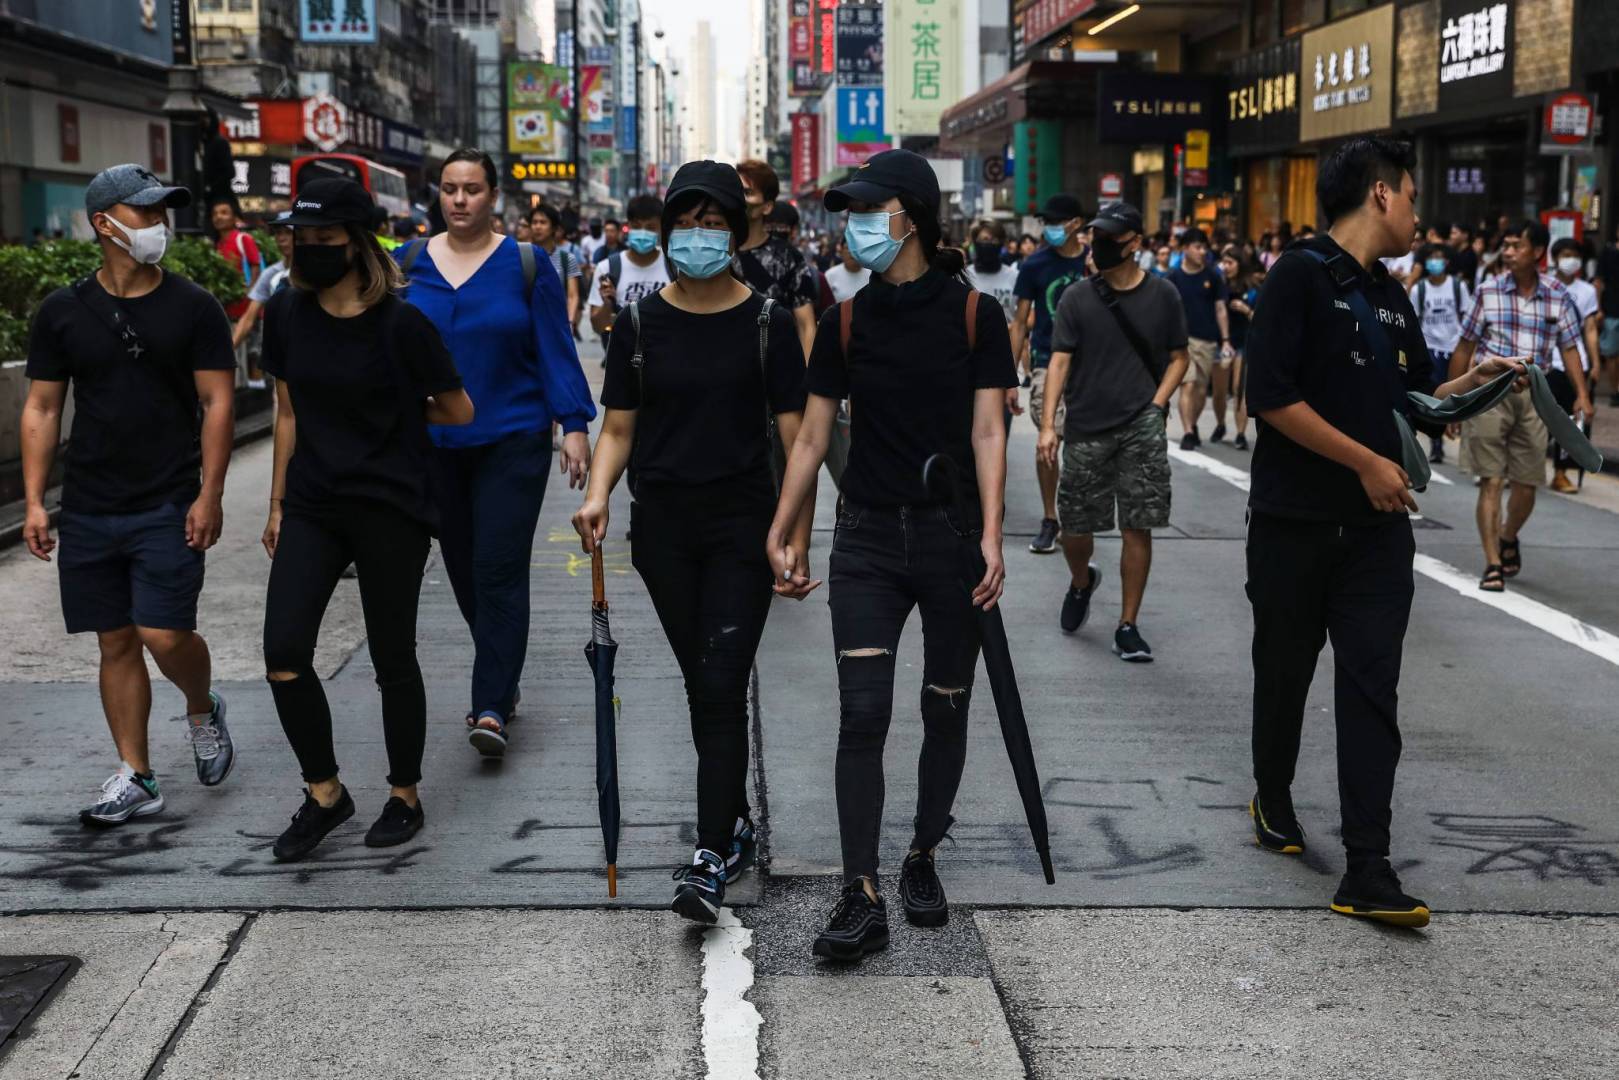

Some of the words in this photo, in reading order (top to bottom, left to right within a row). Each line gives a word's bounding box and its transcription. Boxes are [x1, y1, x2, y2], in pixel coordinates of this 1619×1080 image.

[848, 90, 880, 126] i.t
[1113, 101, 1153, 114] TSL
[1229, 86, 1257, 121] TSL
